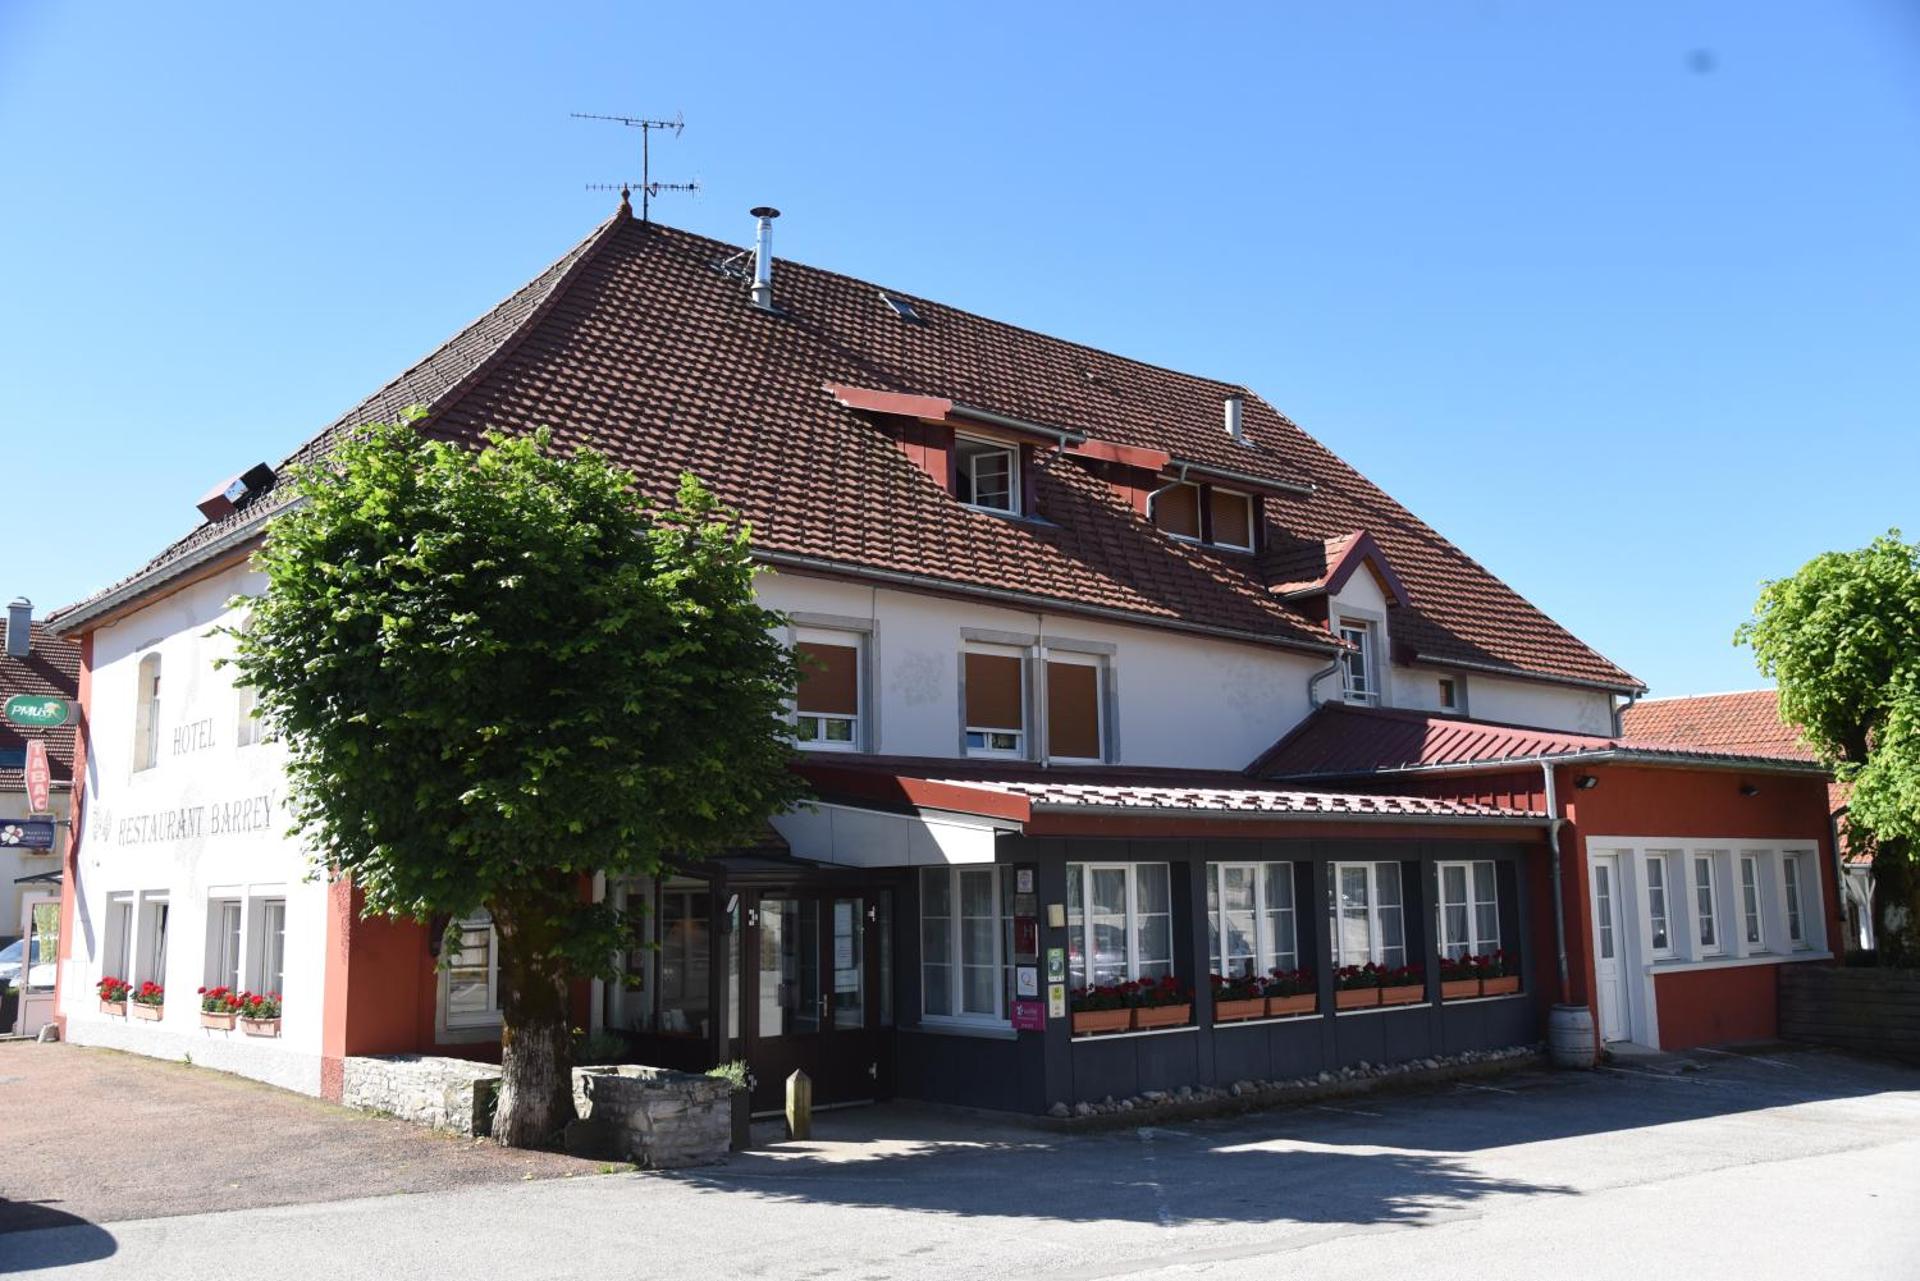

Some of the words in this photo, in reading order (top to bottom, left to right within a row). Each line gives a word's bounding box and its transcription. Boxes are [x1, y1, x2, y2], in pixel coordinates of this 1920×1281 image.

[11, 705, 44, 718] PMU
[173, 718, 216, 756] HOTEL
[29, 741, 48, 811] TABAC
[118, 806, 204, 847] RESTAURANT
[211, 793, 273, 834] BARREY
